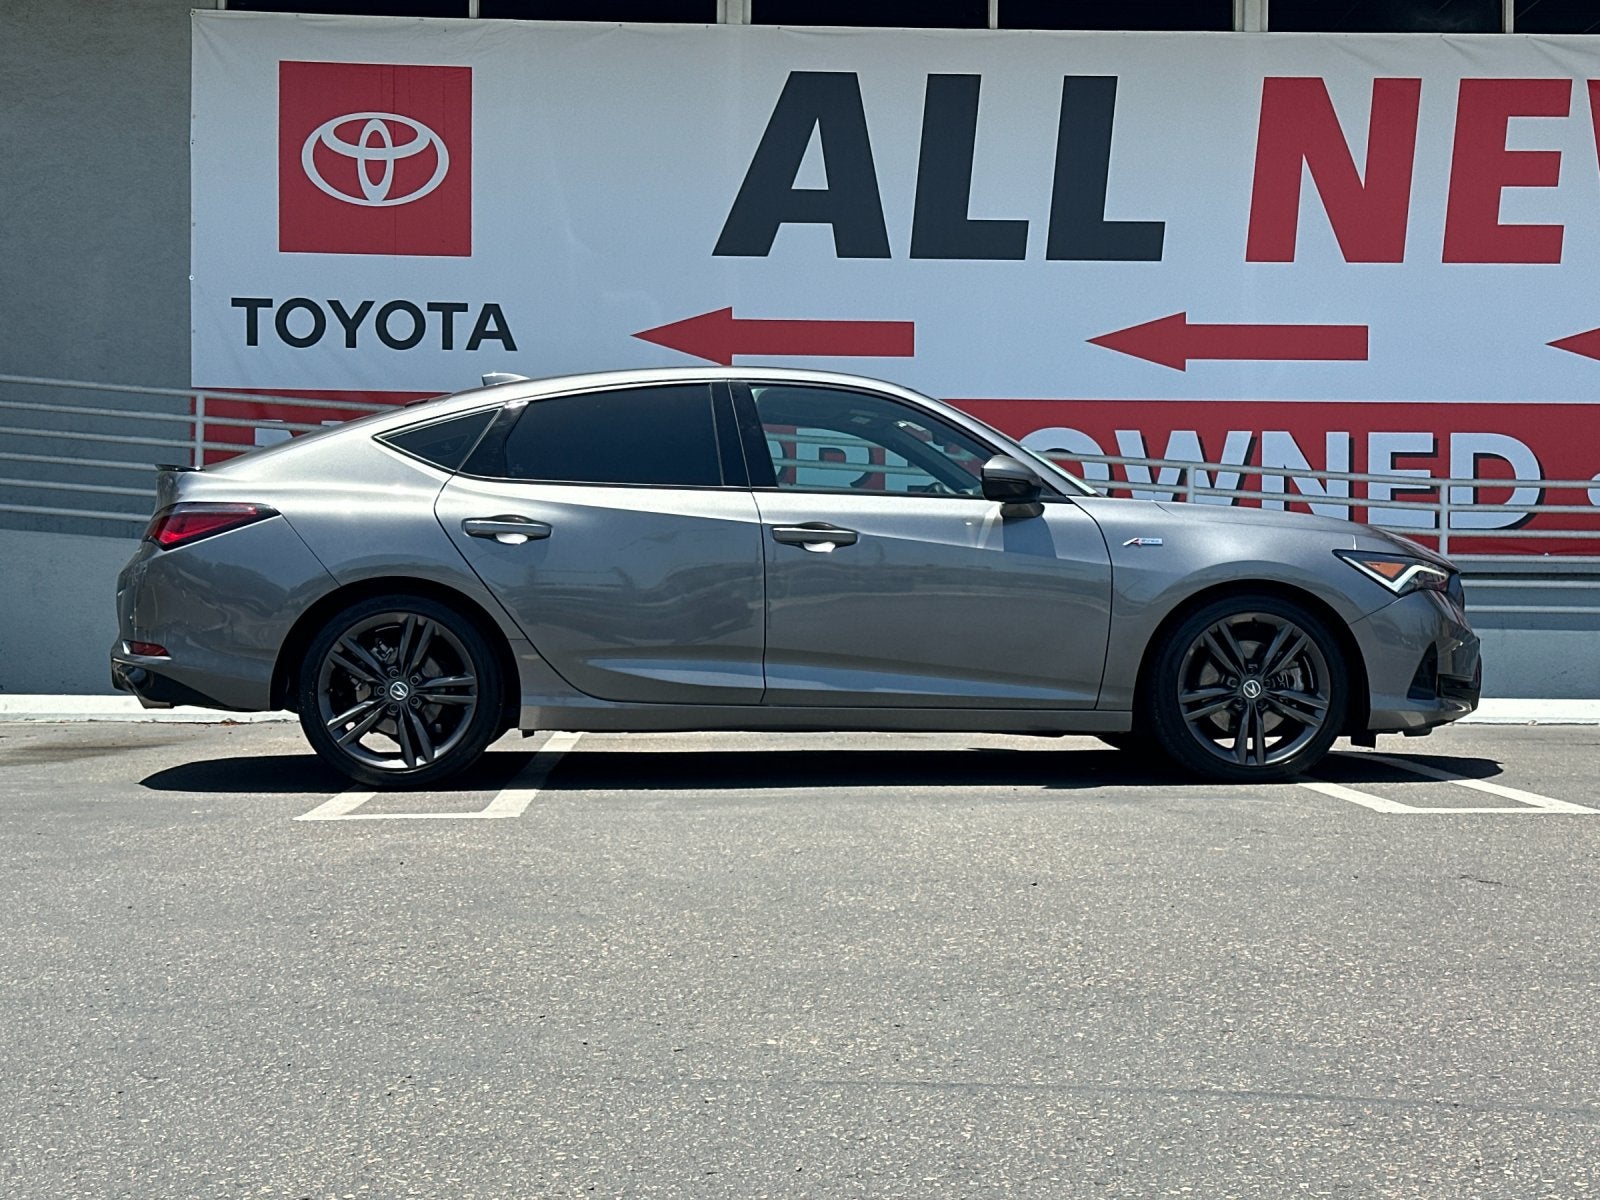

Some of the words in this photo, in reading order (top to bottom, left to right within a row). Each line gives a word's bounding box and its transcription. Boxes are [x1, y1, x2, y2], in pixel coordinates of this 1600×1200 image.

[712, 71, 1165, 261] ALL
[1247, 78, 1600, 264] NE
[231, 297, 518, 351] TOYOTA
